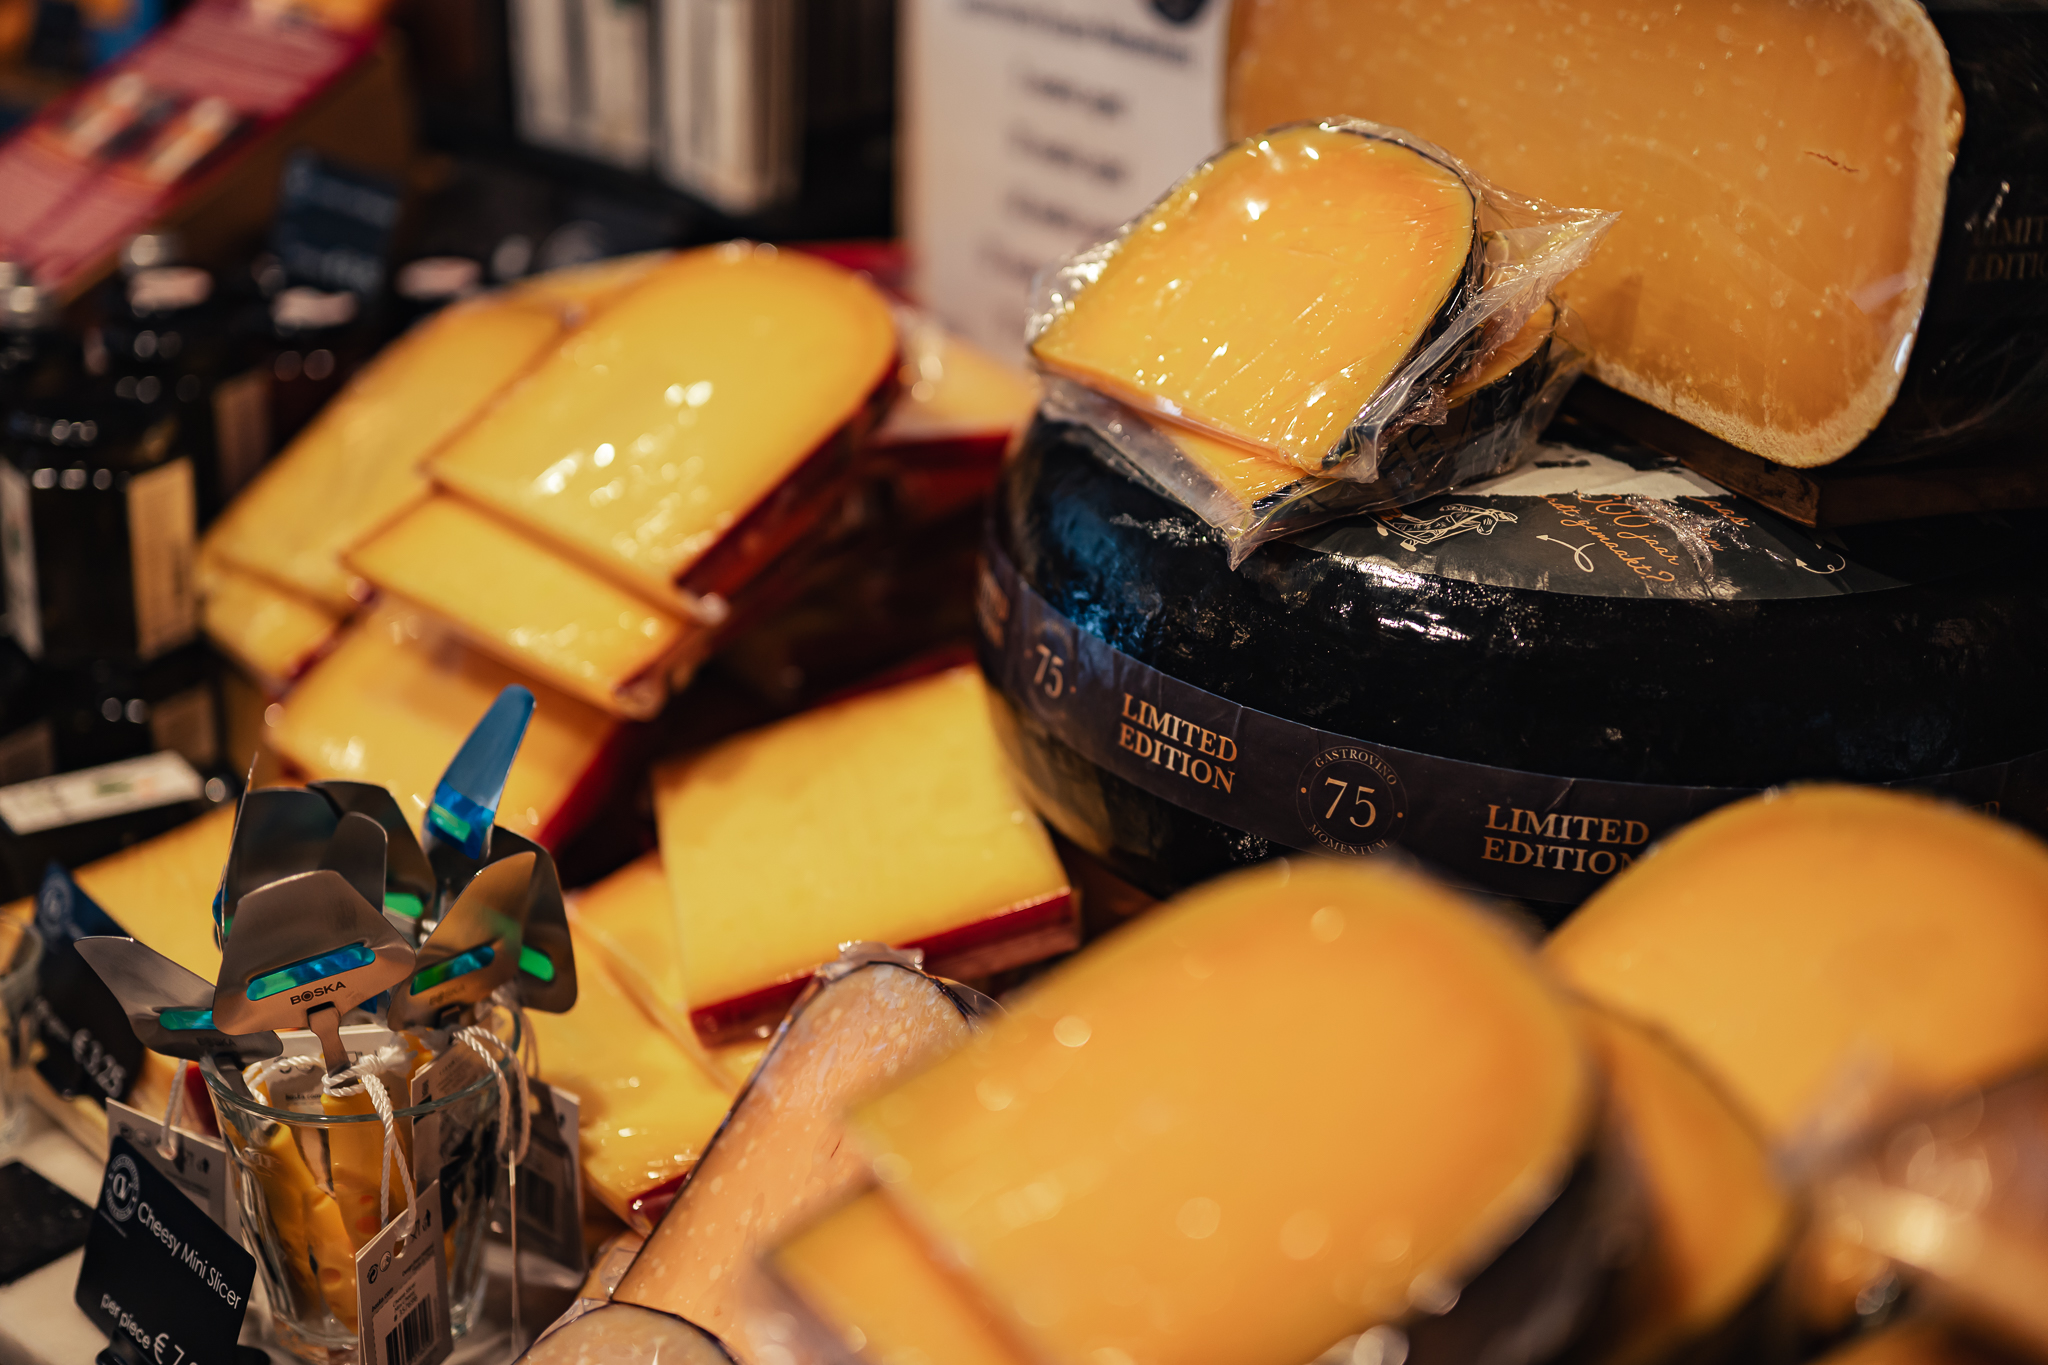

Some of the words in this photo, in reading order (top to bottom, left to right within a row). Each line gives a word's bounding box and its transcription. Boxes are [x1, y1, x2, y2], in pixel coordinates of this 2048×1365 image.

[1560, 519, 1675, 582] gemaakt?
[1617, 531, 1679, 565] jaar
[1033, 643, 1064, 699] 75
[1121, 692, 1238, 763] LIMITED
[1118, 722, 1236, 794] EDITION
[1315, 749, 1397, 785] GASTROVINO
[1324, 776, 1377, 828] 75
[1485, 803, 1651, 846] LIMITED
[1309, 824, 1388, 855] MOMENTUM
[290, 981, 347, 1006] BOSKA
[137, 1202, 181, 1257] Cheesy
[180, 1243, 208, 1280] Mini
[206, 1267, 242, 1309] Slicer
[101, 1293, 122, 1319] per
[119, 1313, 152, 1349] piece
[153, 1333, 170, 1365] €
